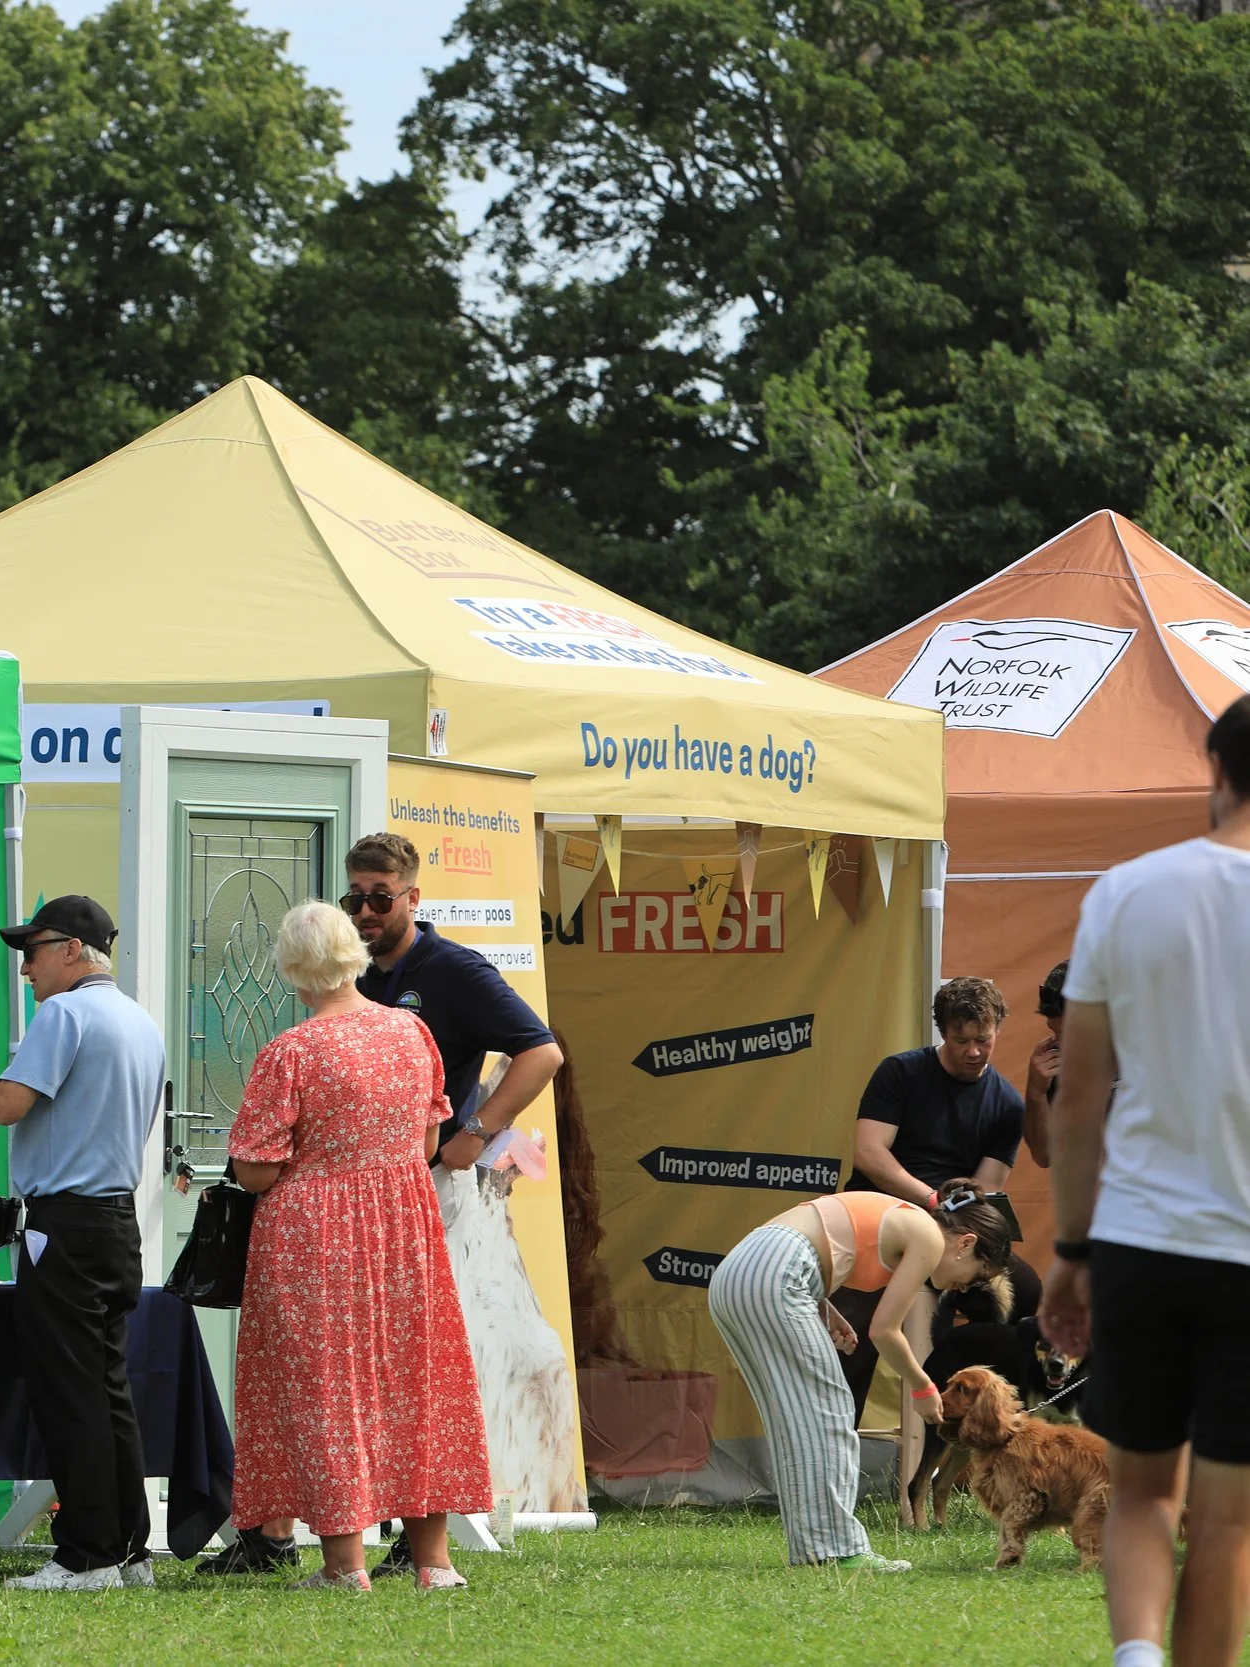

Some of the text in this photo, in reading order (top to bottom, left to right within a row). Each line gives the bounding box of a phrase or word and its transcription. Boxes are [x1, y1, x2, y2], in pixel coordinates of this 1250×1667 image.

[396, 545, 471, 569] Box
[453, 598, 537, 630] Try
[526, 606, 558, 626] a
[484, 633, 576, 660] take
[566, 642, 621, 662] on
[937, 656, 1073, 680] NORFOLK
[934, 679, 1051, 701] WILDLIFE
[29, 726, 89, 764] on
[580, 722, 817, 794] Do you have a dog?
[390, 798, 521, 834] Unleash the benefits
[428, 836, 493, 869] of Fresh
[450, 905, 483, 921] firmer
[485, 908, 512, 925] poos
[600, 894, 783, 952] FRESH
[652, 1019, 812, 1071] Healthy weight
[658, 1150, 839, 1188] Improved appetite
[658, 1251, 719, 1280] Stron
